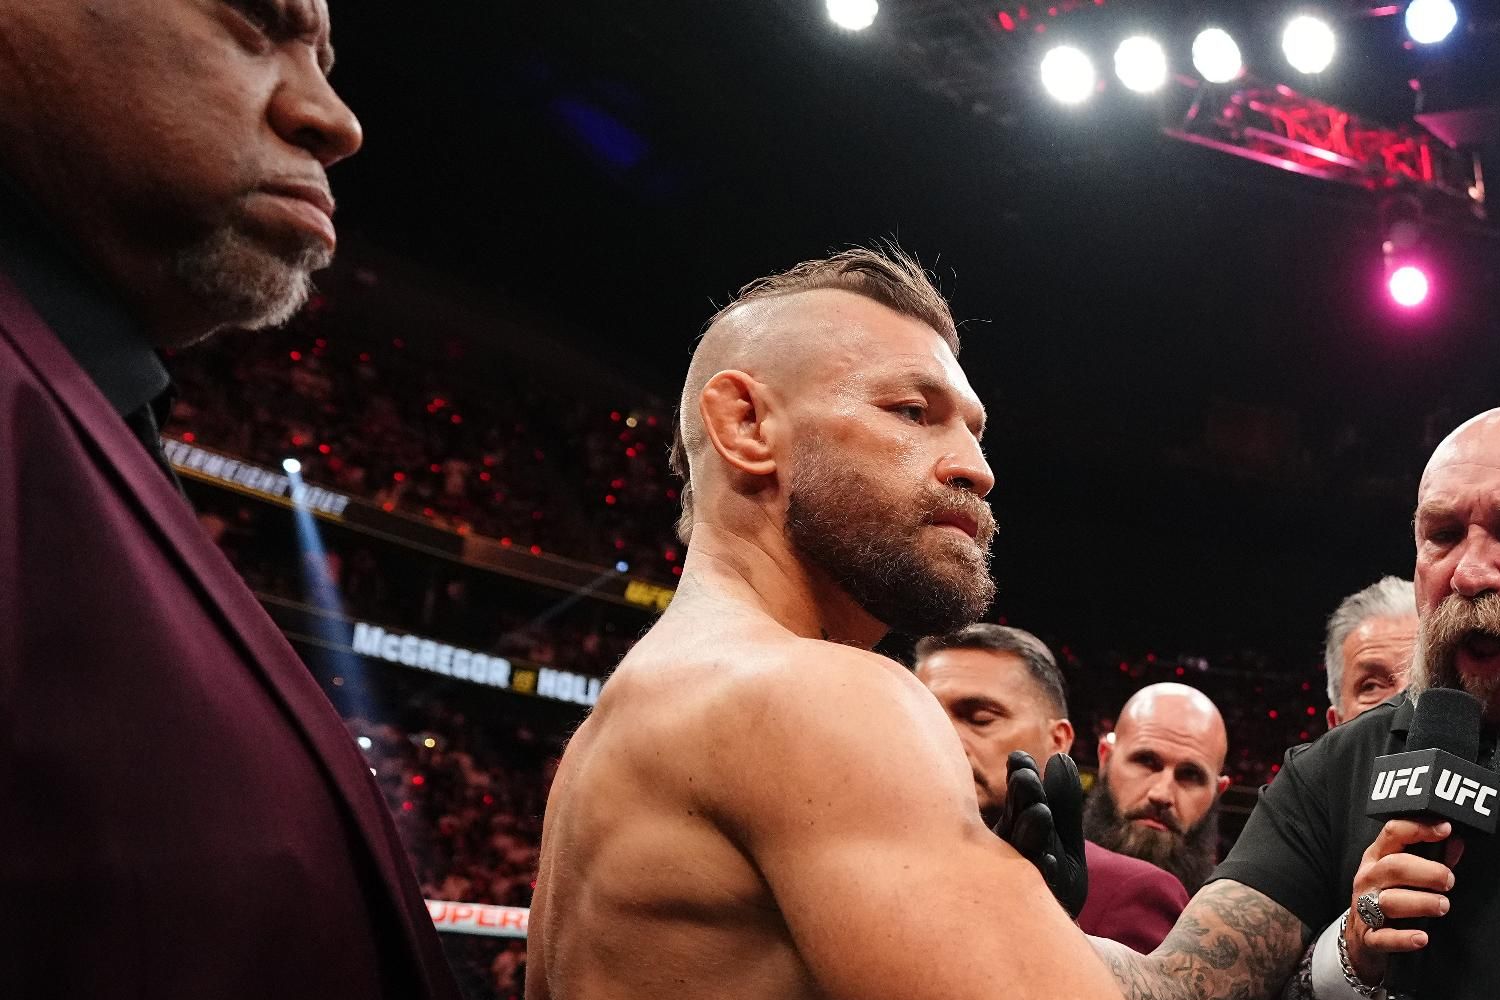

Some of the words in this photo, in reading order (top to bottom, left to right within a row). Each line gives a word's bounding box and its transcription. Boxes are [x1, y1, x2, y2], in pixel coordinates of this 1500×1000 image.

[352, 622, 511, 689] McGREGOR
[1371, 765, 1430, 801] UFC
[1434, 768, 1498, 817] UFC
